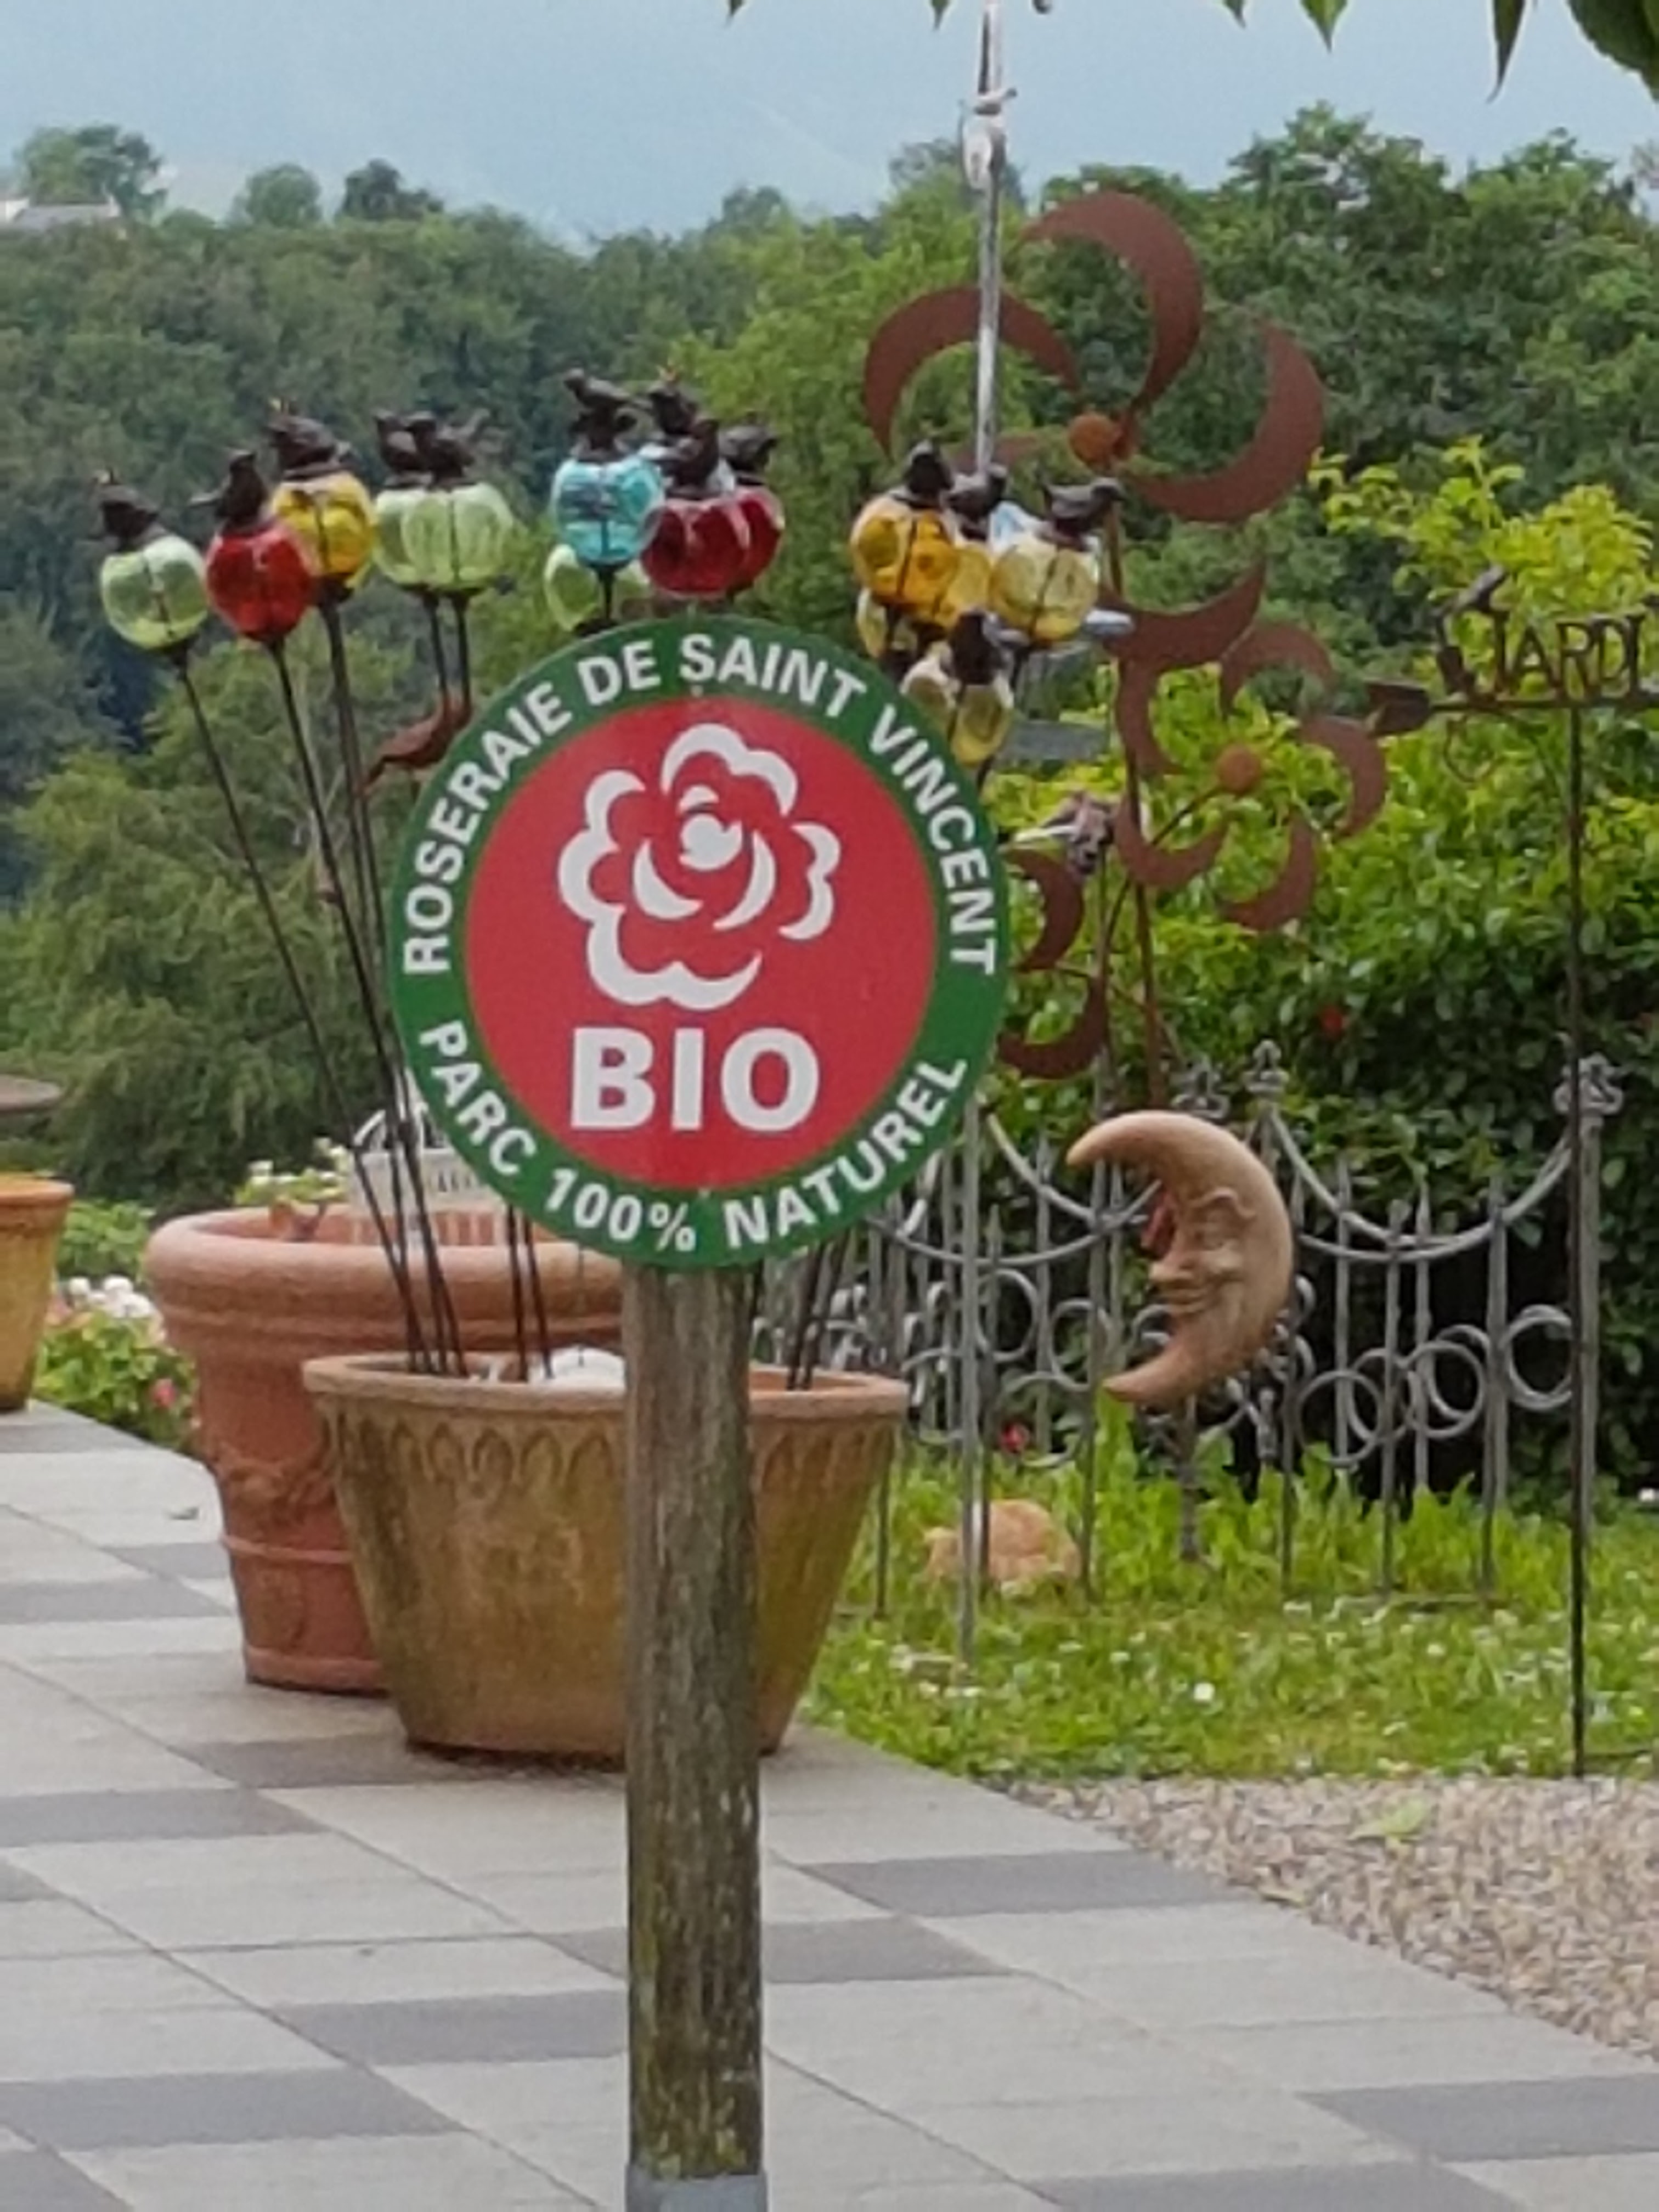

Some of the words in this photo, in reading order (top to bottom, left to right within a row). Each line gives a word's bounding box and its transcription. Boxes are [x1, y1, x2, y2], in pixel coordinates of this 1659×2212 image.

[402, 681, 573, 975] ROSERAIE
[576, 640, 662, 706] DE
[679, 633, 867, 718] SAINT
[869, 703, 997, 976] VINCENT
[418, 1020, 538, 1177] PARC
[545, 1167, 696, 1252] 100%
[722, 1060, 968, 1249] NATUREL
[571, 1026, 819, 1132] BIO
